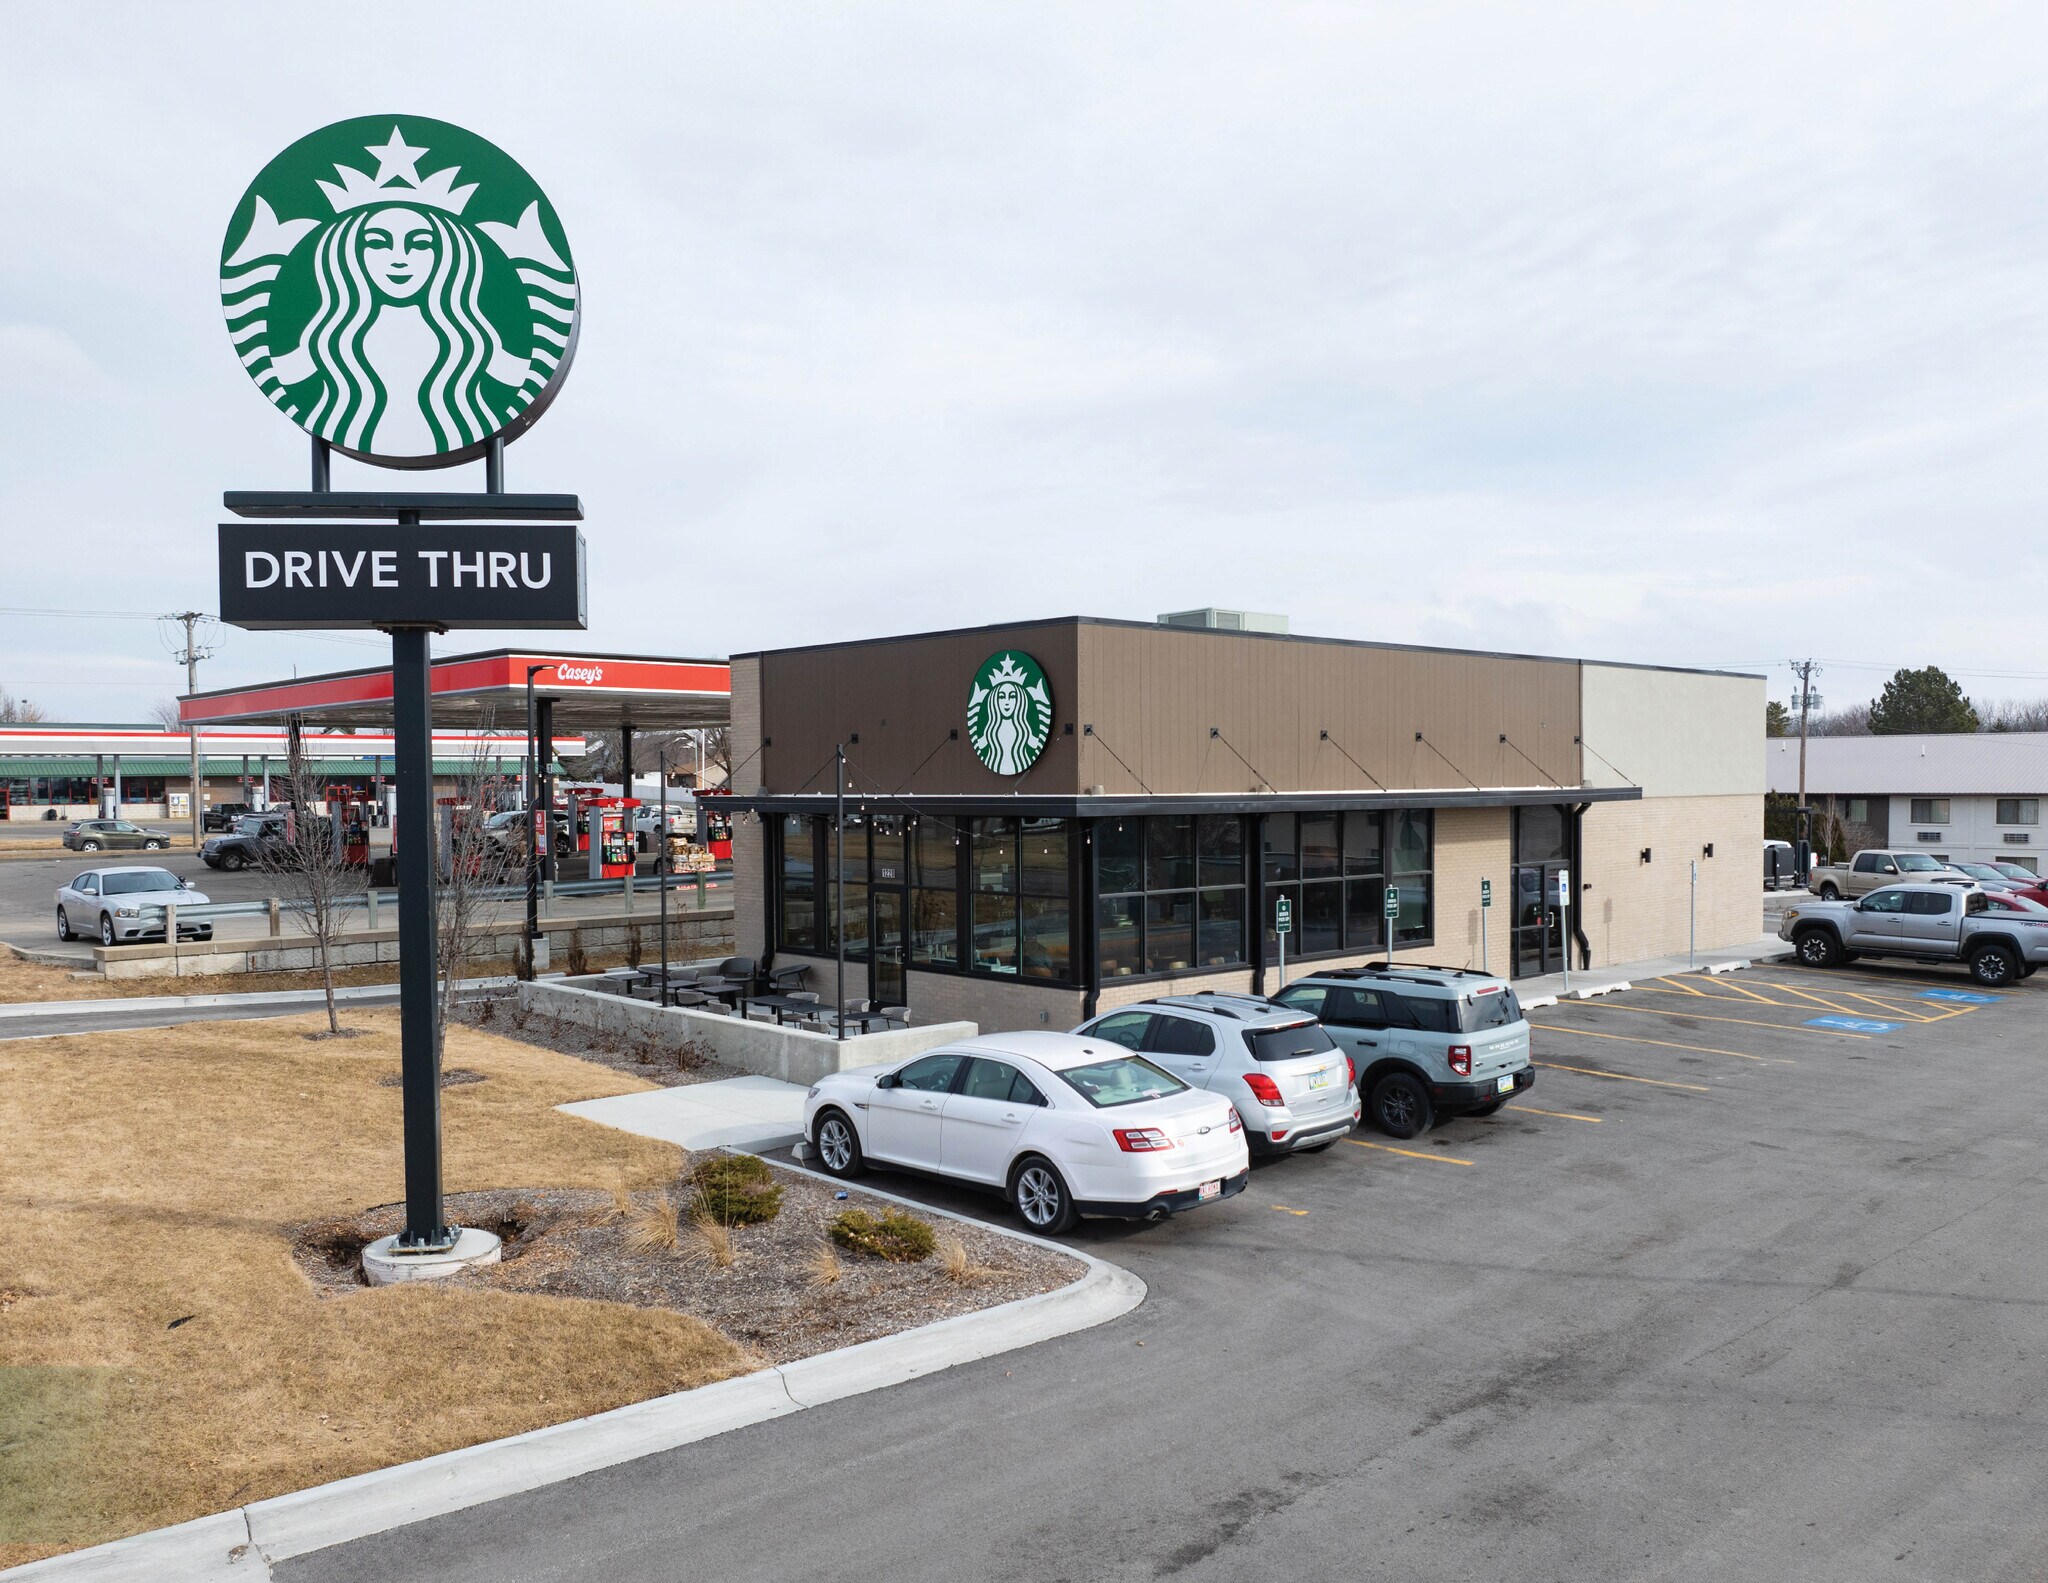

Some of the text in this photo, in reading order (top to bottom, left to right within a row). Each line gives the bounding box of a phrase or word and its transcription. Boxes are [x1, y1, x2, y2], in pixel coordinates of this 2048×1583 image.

[245, 551, 552, 589] DRIVE THRU
[557, 663, 603, 685] Casey's
